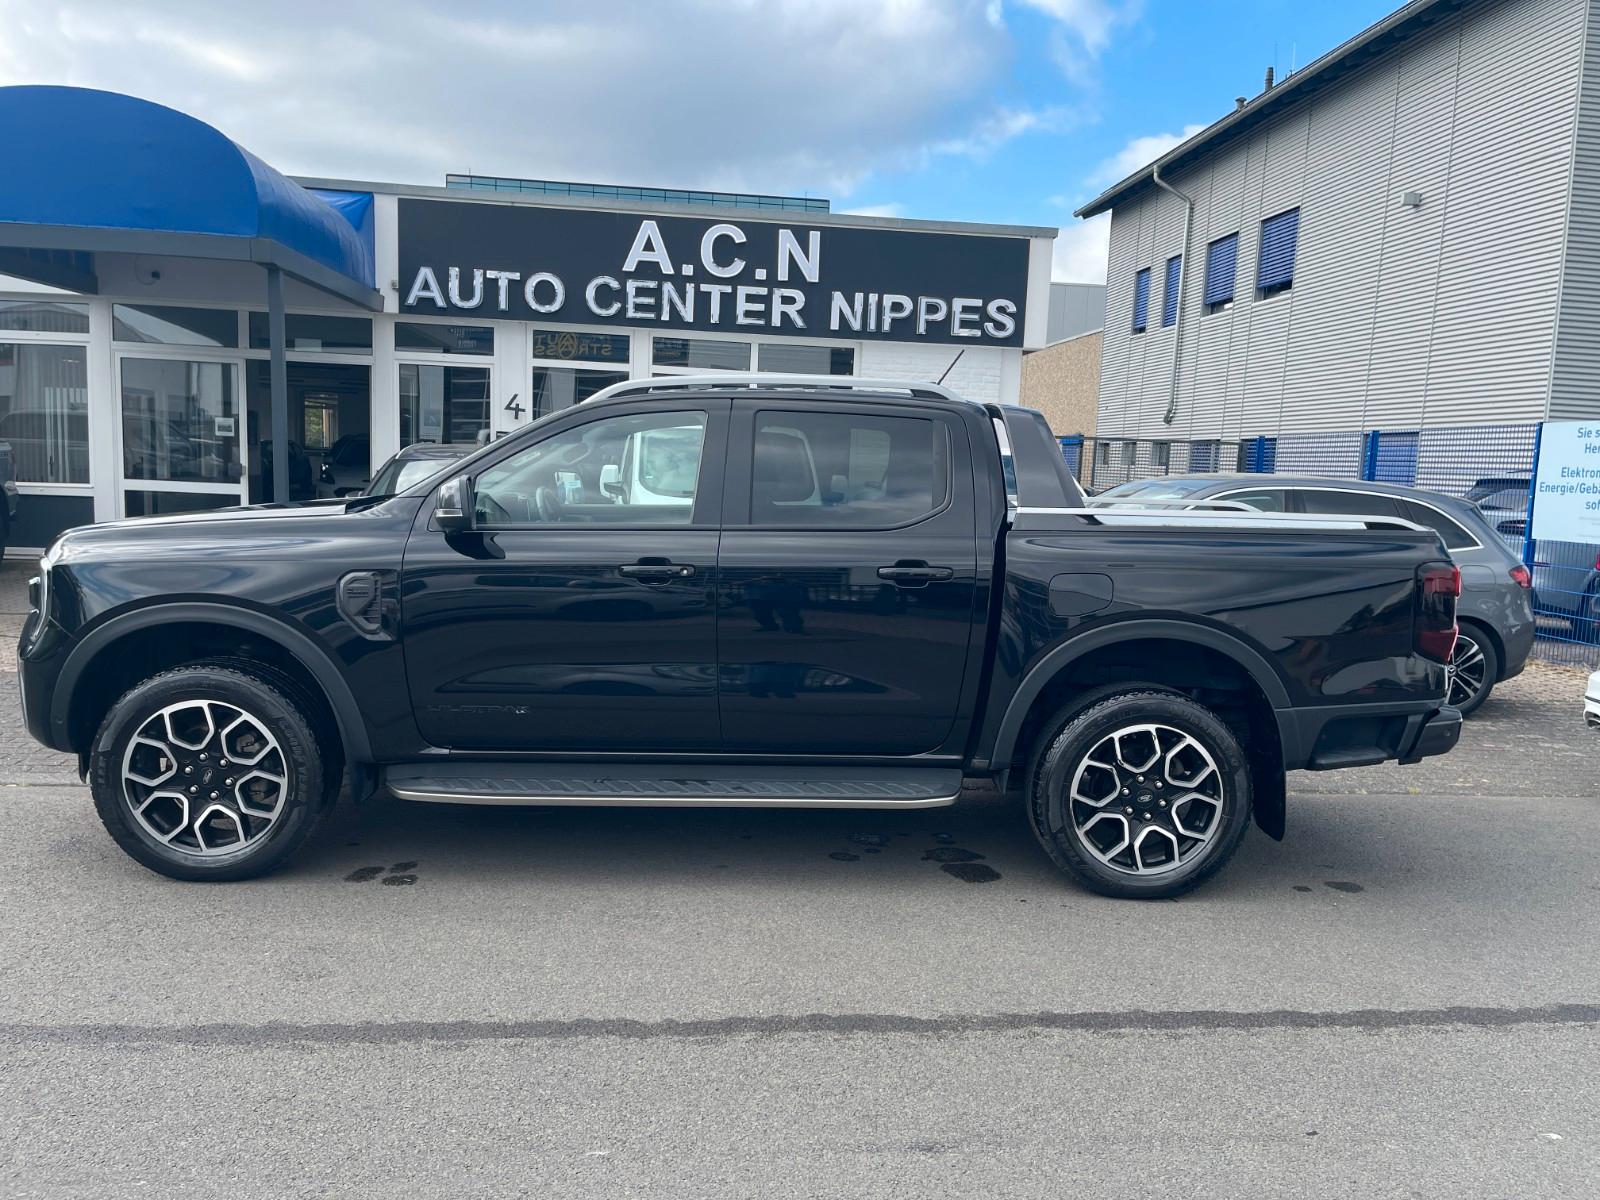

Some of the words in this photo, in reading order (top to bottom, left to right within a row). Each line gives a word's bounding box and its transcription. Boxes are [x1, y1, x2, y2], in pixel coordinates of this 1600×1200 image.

[622, 219, 821, 283] A.C.N
[405, 265, 566, 314] AUTO
[585, 275, 807, 329] CENTER
[830, 291, 1017, 338] NIPPES
[504, 393, 526, 420] 4
[1577, 427, 1593, 438] Sie
